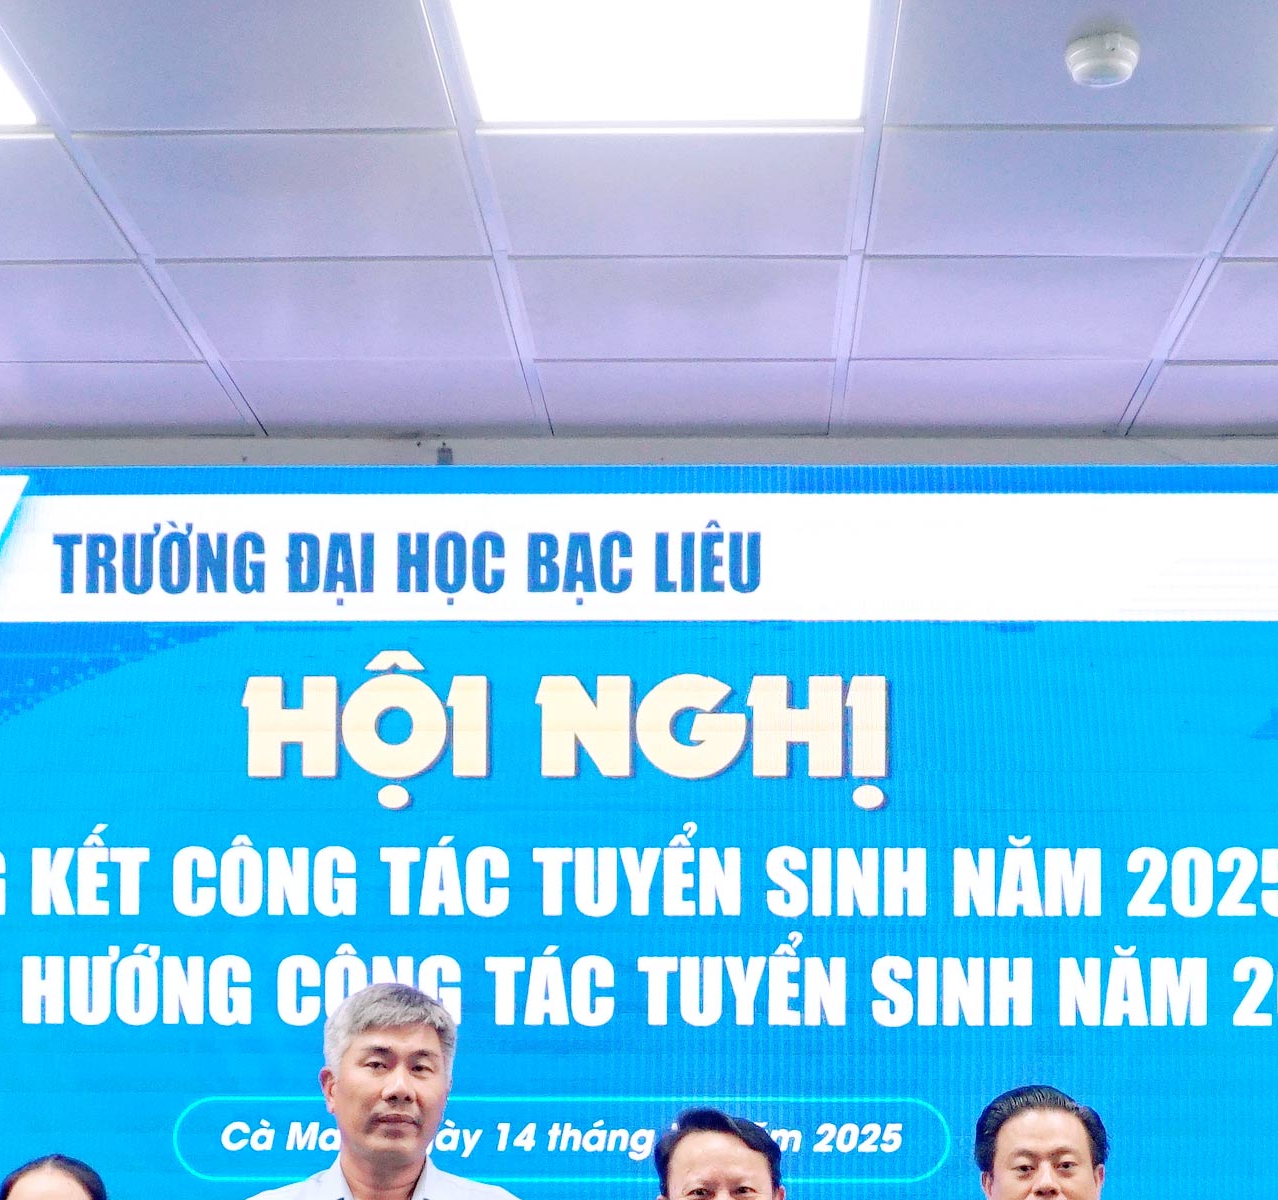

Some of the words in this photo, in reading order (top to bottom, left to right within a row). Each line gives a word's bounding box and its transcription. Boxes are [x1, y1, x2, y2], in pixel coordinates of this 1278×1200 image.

[52, 521, 266, 595] TRƯỜNG
[285, 532, 375, 606] ĐẠI
[397, 532, 506, 606] HỌC
[527, 532, 633, 606] BẠC
[654, 520, 761, 594] LIÊU
[241, 650, 491, 810] HỘI
[534, 673, 890, 810] NGHỊ
[31, 823, 150, 916] KẾT
[172, 835, 357, 917] CÔNG
[379, 836, 510, 917] TÁC
[532, 822, 742, 917] TUYỂN
[765, 846, 927, 917] SINH
[953, 836, 1102, 917] NĂM
[21, 943, 252, 1026] HƯỚNG
[484, 945, 615, 1026] TÁC
[637, 931, 847, 1026] TUYỂN
[871, 956, 1033, 1027] SINH
[1059, 945, 1208, 1026] NĂM
[221, 1119, 275, 1151] Cà
[286, 1121, 341, 1151] Ma
[497, 1122, 536, 1152] 14
[548, 1120, 655, 1160] tháng
[812, 1122, 903, 1153] 2025
